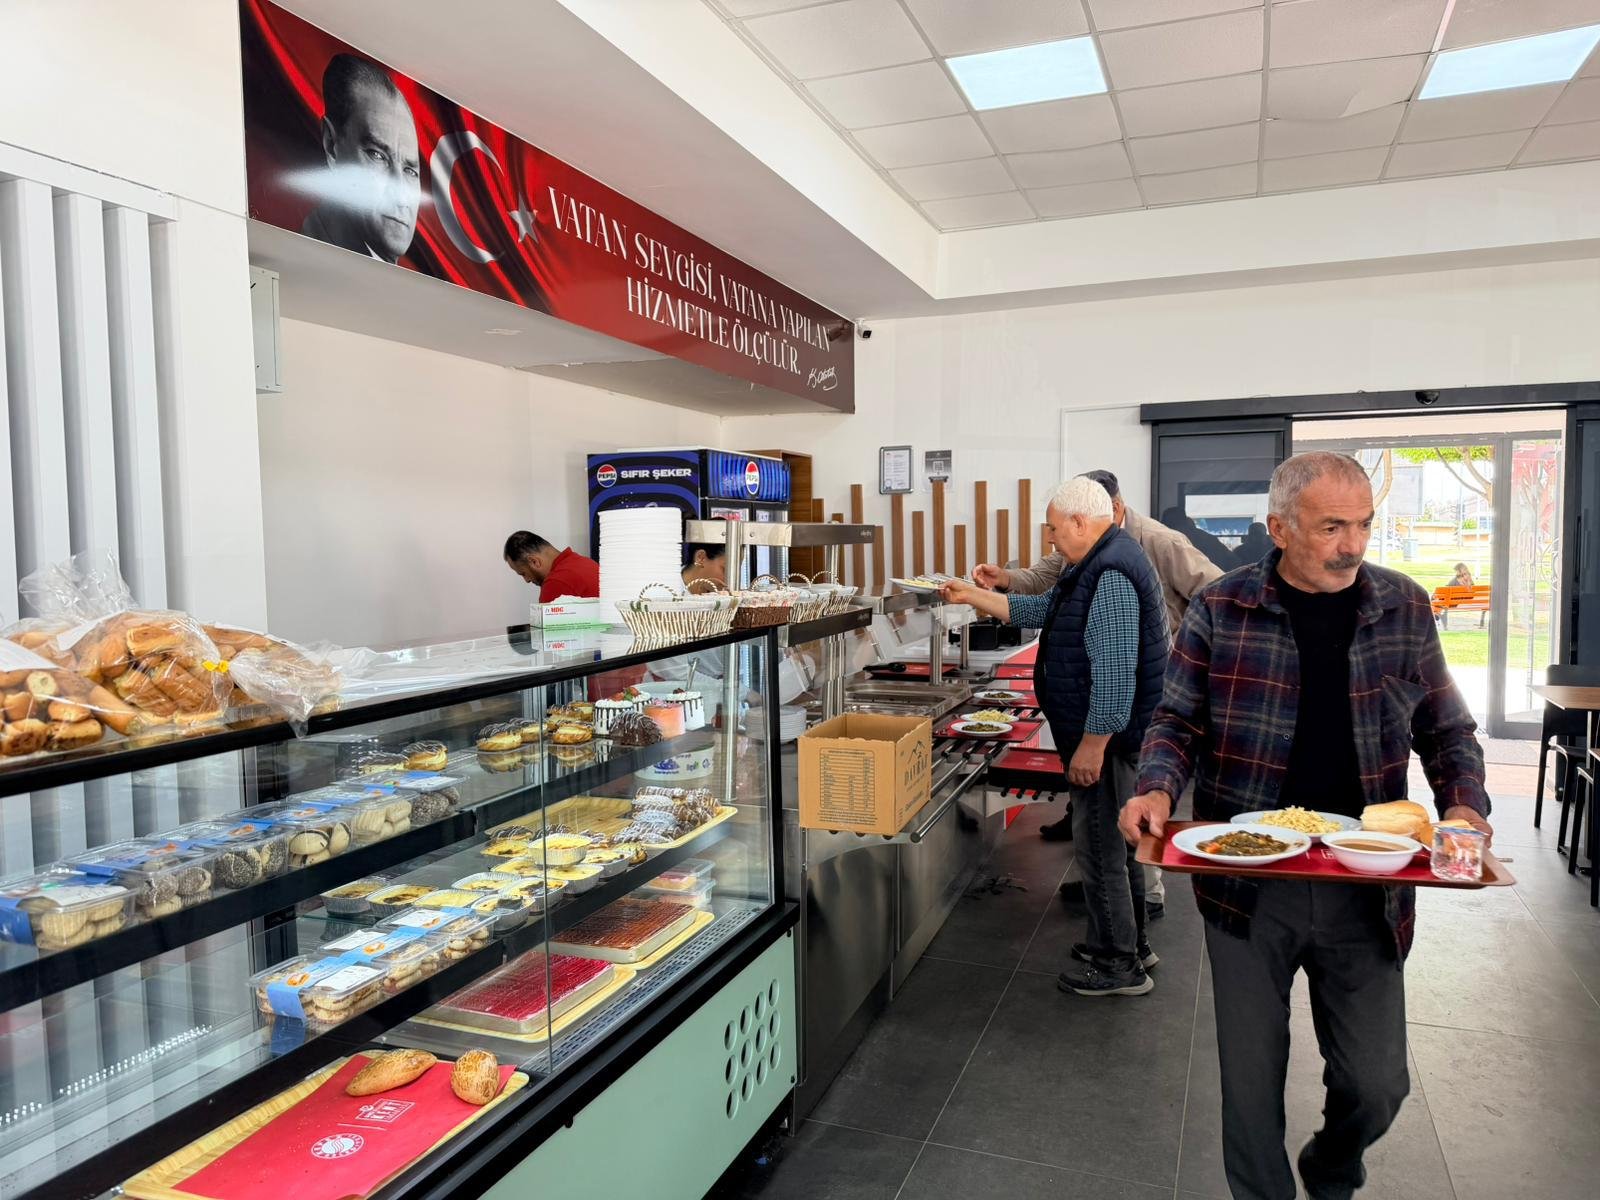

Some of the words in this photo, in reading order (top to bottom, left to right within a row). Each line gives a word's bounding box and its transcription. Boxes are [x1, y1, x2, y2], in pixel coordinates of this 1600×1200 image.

[547, 185, 629, 261] VATAN
[634, 231, 717, 302] SEVGİSİ,
[719, 273, 778, 328] VATANA
[779, 303, 832, 353] YAPILAN
[626, 275, 730, 349] HİZMETLE
[732, 319, 802, 376] ÖLÇÜLÜR.
[620, 469, 651, 479] SIFIR
[652, 468, 692, 480] ŞEKER
